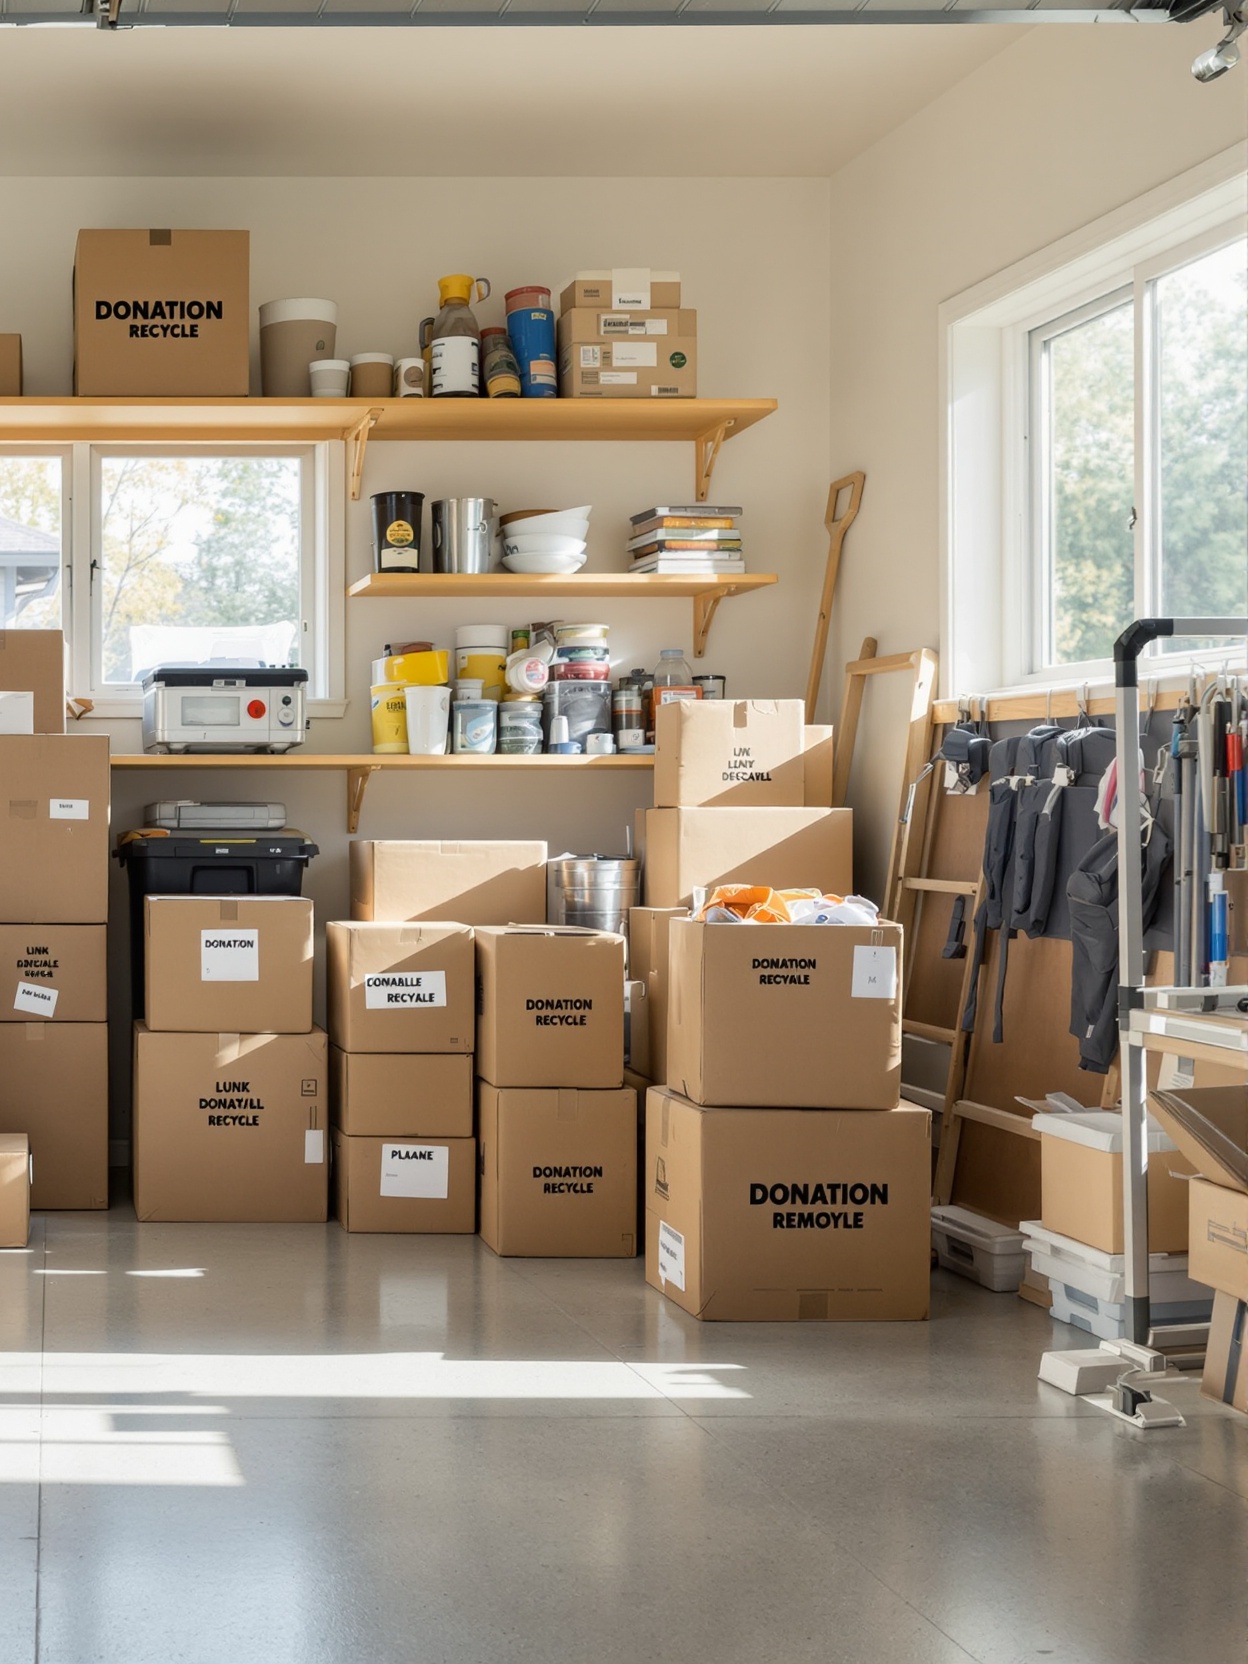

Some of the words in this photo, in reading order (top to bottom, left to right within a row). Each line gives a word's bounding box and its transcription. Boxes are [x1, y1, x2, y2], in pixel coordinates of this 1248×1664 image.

[95, 300, 223, 320] DONATION
[129, 324, 199, 338] RECYCLE
[205, 939, 254, 949] DONATION
[752, 958, 817, 970] DONATION
[526, 999, 592, 1011] DONATION
[535, 1015, 587, 1026] RECYCLE
[215, 1081, 250, 1093] LUNK
[208, 1115, 259, 1126] RECYCLE
[532, 1166, 603, 1179] DONATION
[543, 1183, 594, 1194] RECYCLE
[750, 1183, 888, 1206] DONATION
[772, 1211, 864, 1229] REMOYLE
